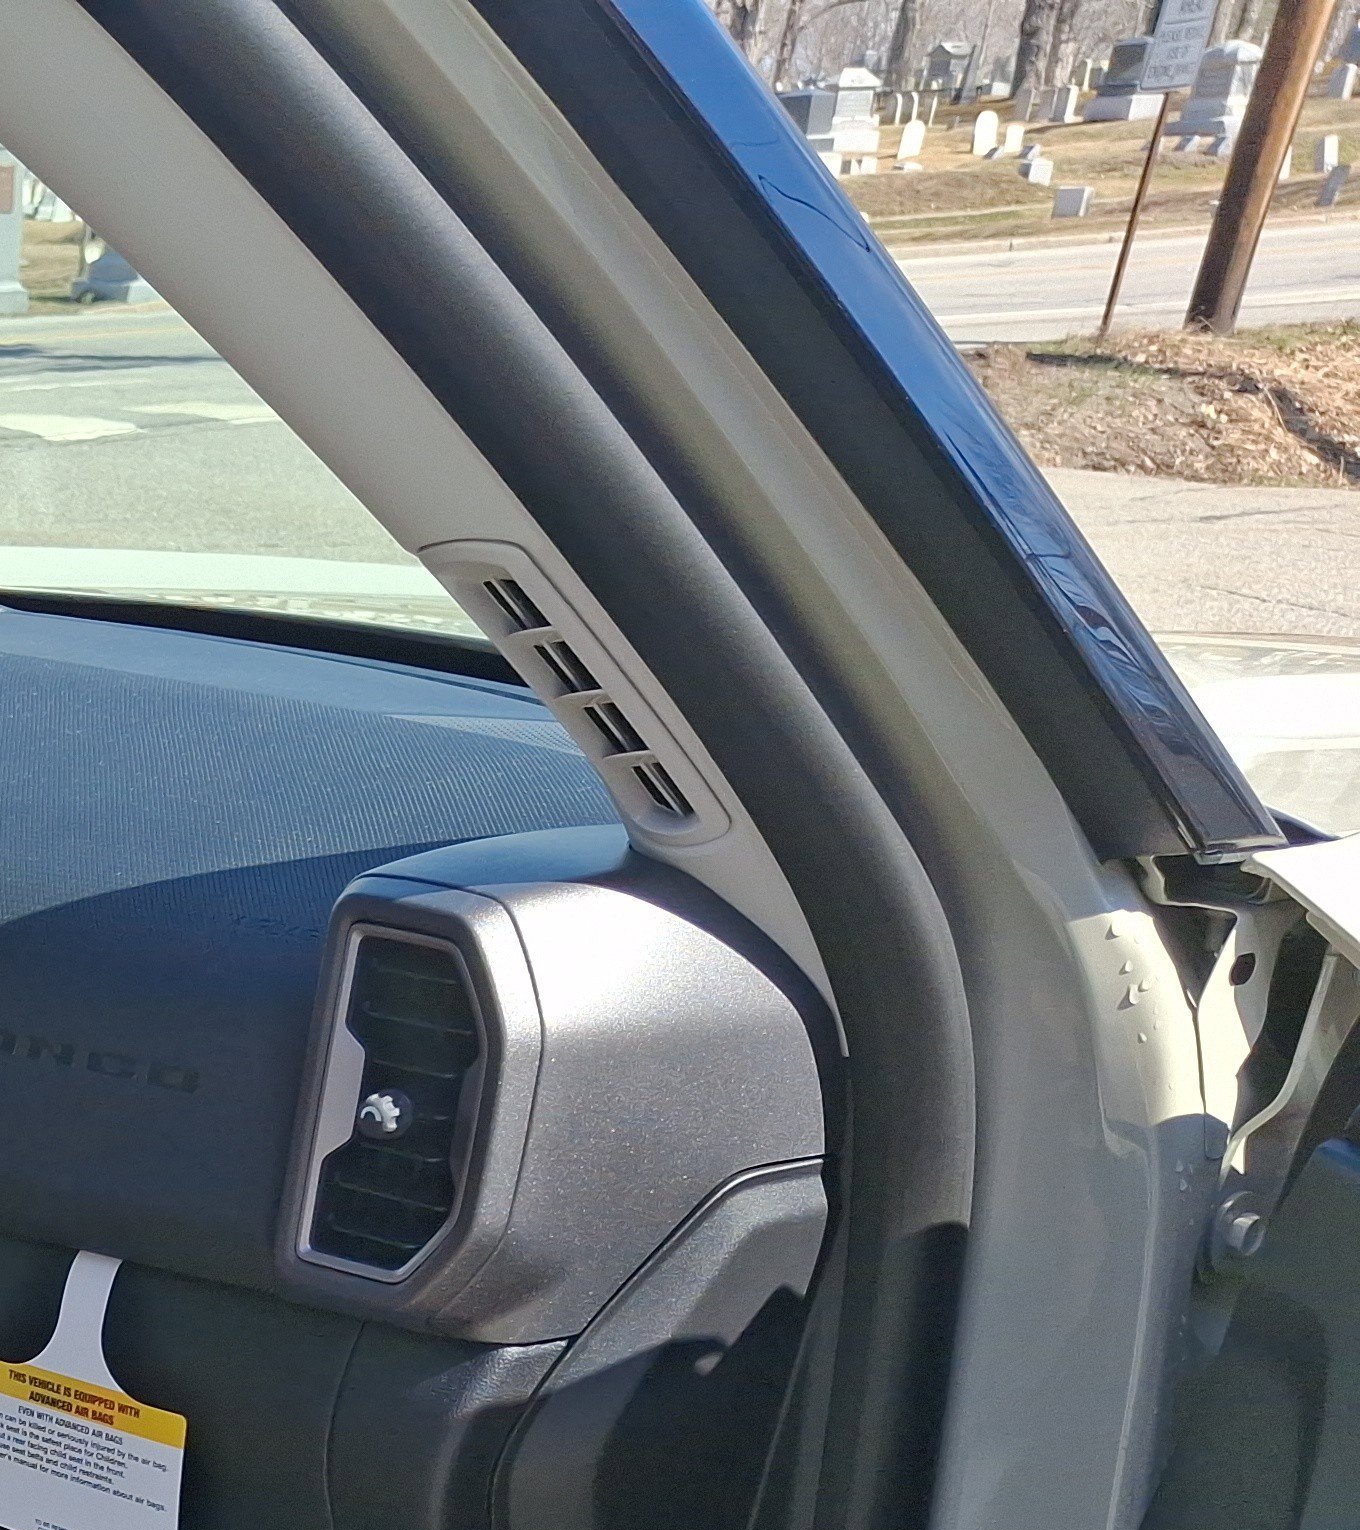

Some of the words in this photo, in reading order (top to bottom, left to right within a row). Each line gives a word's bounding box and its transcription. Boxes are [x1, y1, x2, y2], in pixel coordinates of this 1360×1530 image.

[9, 1369, 27, 1384] THIS
[29, 1375, 62, 1394] VEHICLE
[63, 1386, 72, 1397] IS
[74, 1390, 116, 1411] EQUIPPED
[118, 1402, 140, 1418] WITH
[29, 1391, 73, 1412] ADVANCED
[74, 1405, 89, 1418] AIR
[91, 1410, 115, 1426] BAGS
[5, 1414, 17, 1422] can
[29, 1421, 46, 1433] killed
[117, 1449, 126, 1459] by
[128, 1453, 139, 1462] the
[19, 1405, 35, 1417] EVEN
[37, 1411, 54, 1423] WITH
[55, 1417, 90, 1435] ADVANCED
[92, 1429, 104, 1439] AIR
[105, 1432, 123, 1445] BAGS
[29, 1431, 40, 1440] the
[63, 1444, 83, 1455] place
[50, 1449, 67, 1460] child
[93, 1461, 105, 1471] the
[70, 1476, 111, 1493] information
[112, 1488, 134, 1500] about
